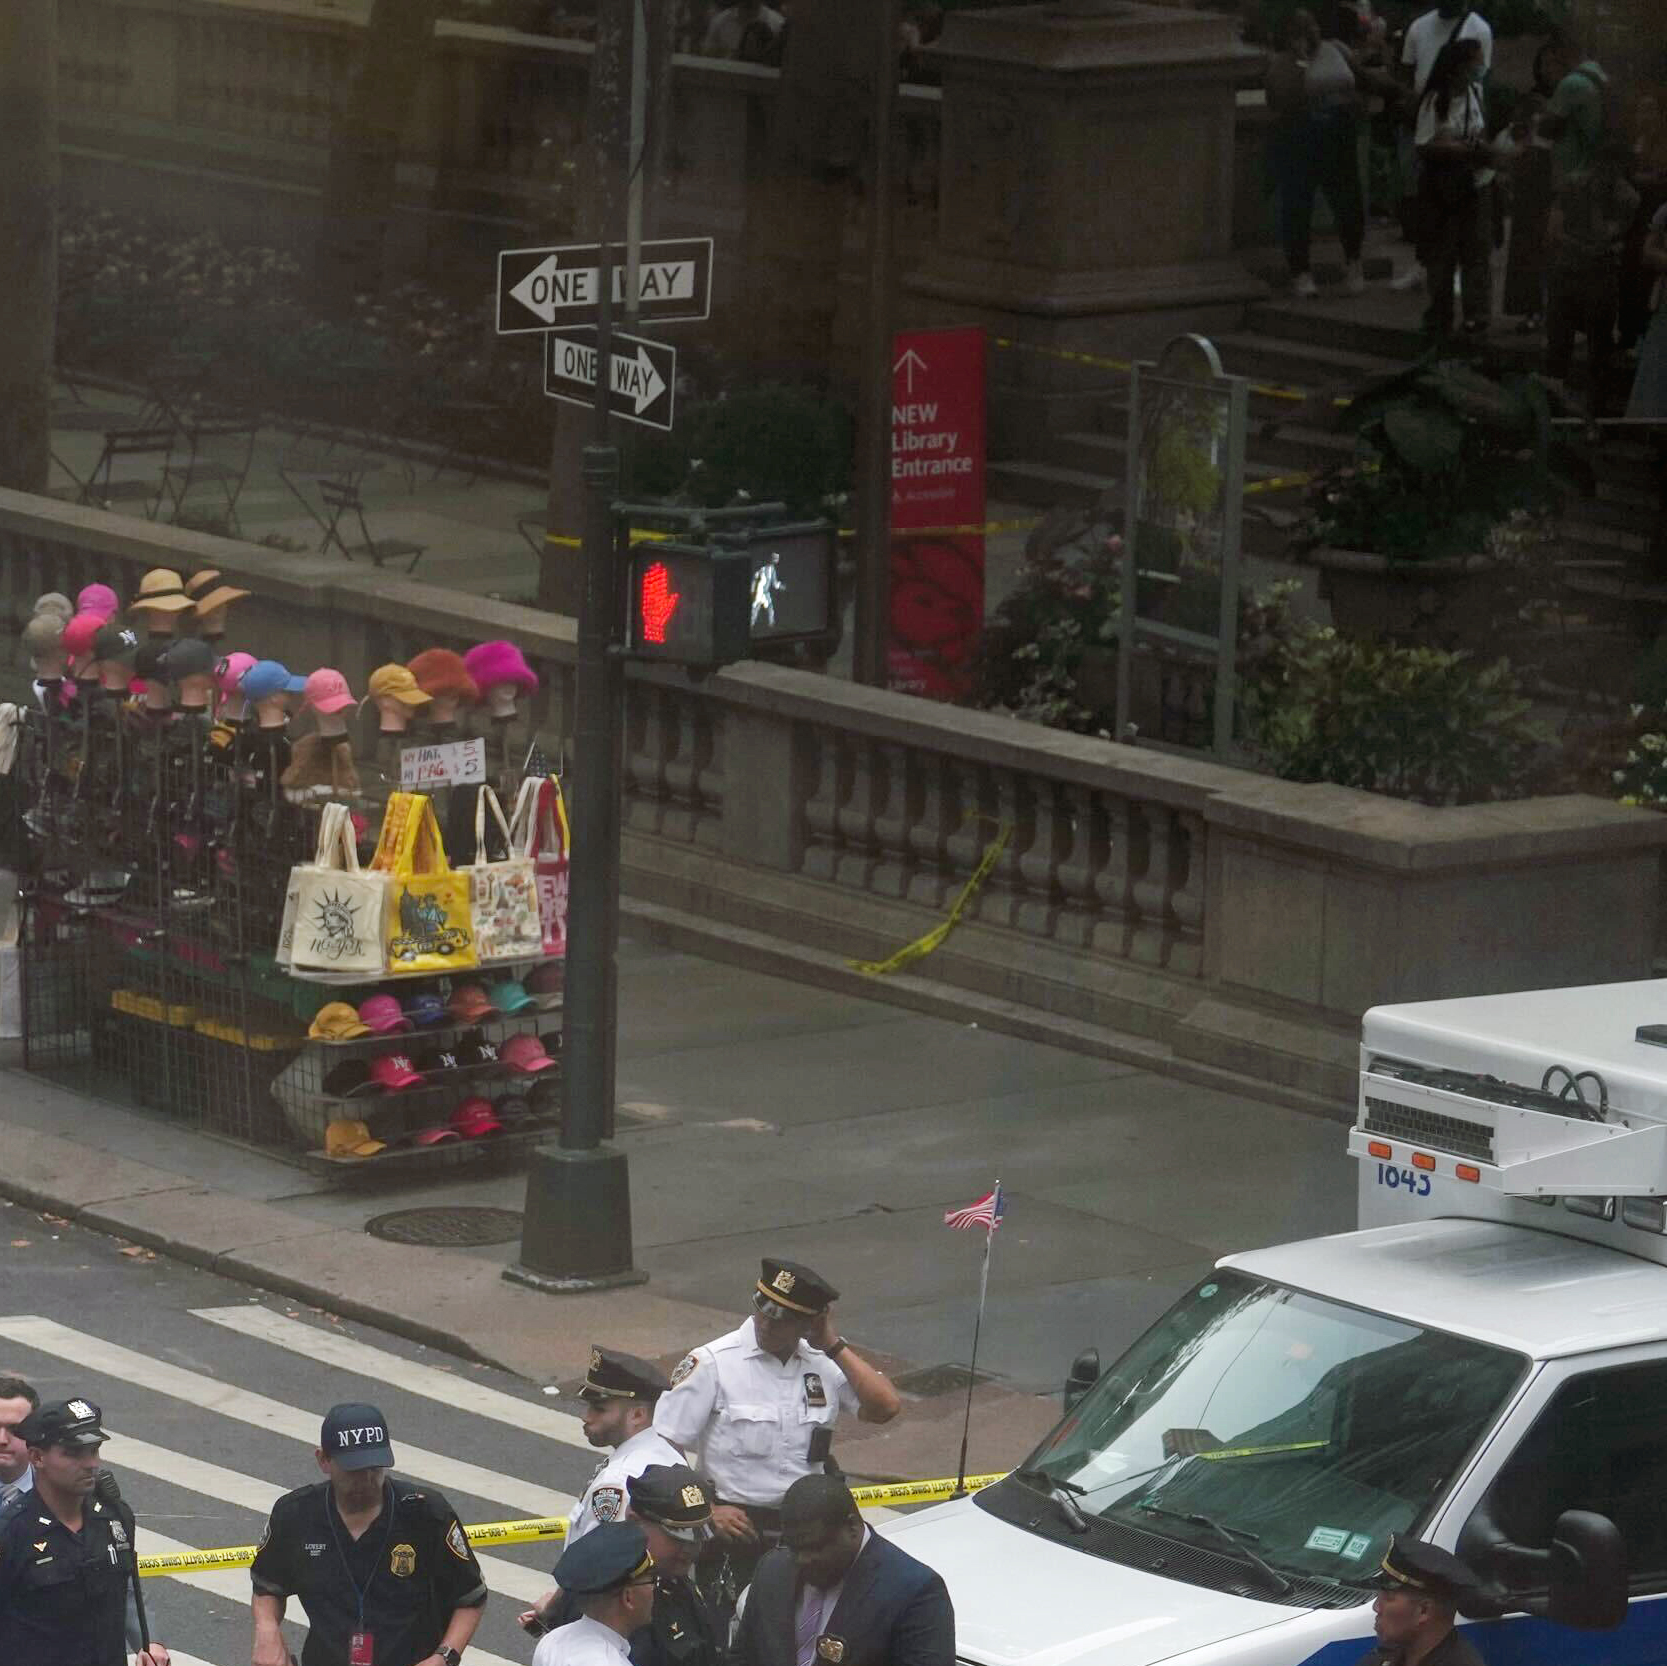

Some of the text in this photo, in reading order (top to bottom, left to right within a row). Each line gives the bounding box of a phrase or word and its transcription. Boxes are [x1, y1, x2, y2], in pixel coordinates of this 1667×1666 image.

[531, 272, 588, 304] ONE
[564, 346, 653, 397] ONE WAY
[892, 401, 938, 425] NEW
[891, 429, 959, 453] Library
[891, 457, 972, 478] Entrance
[337, 1426, 384, 1448] NYPD
[138, 1559, 160, 1569] SCENE
[161, 1556, 182, 1567] CRIME
